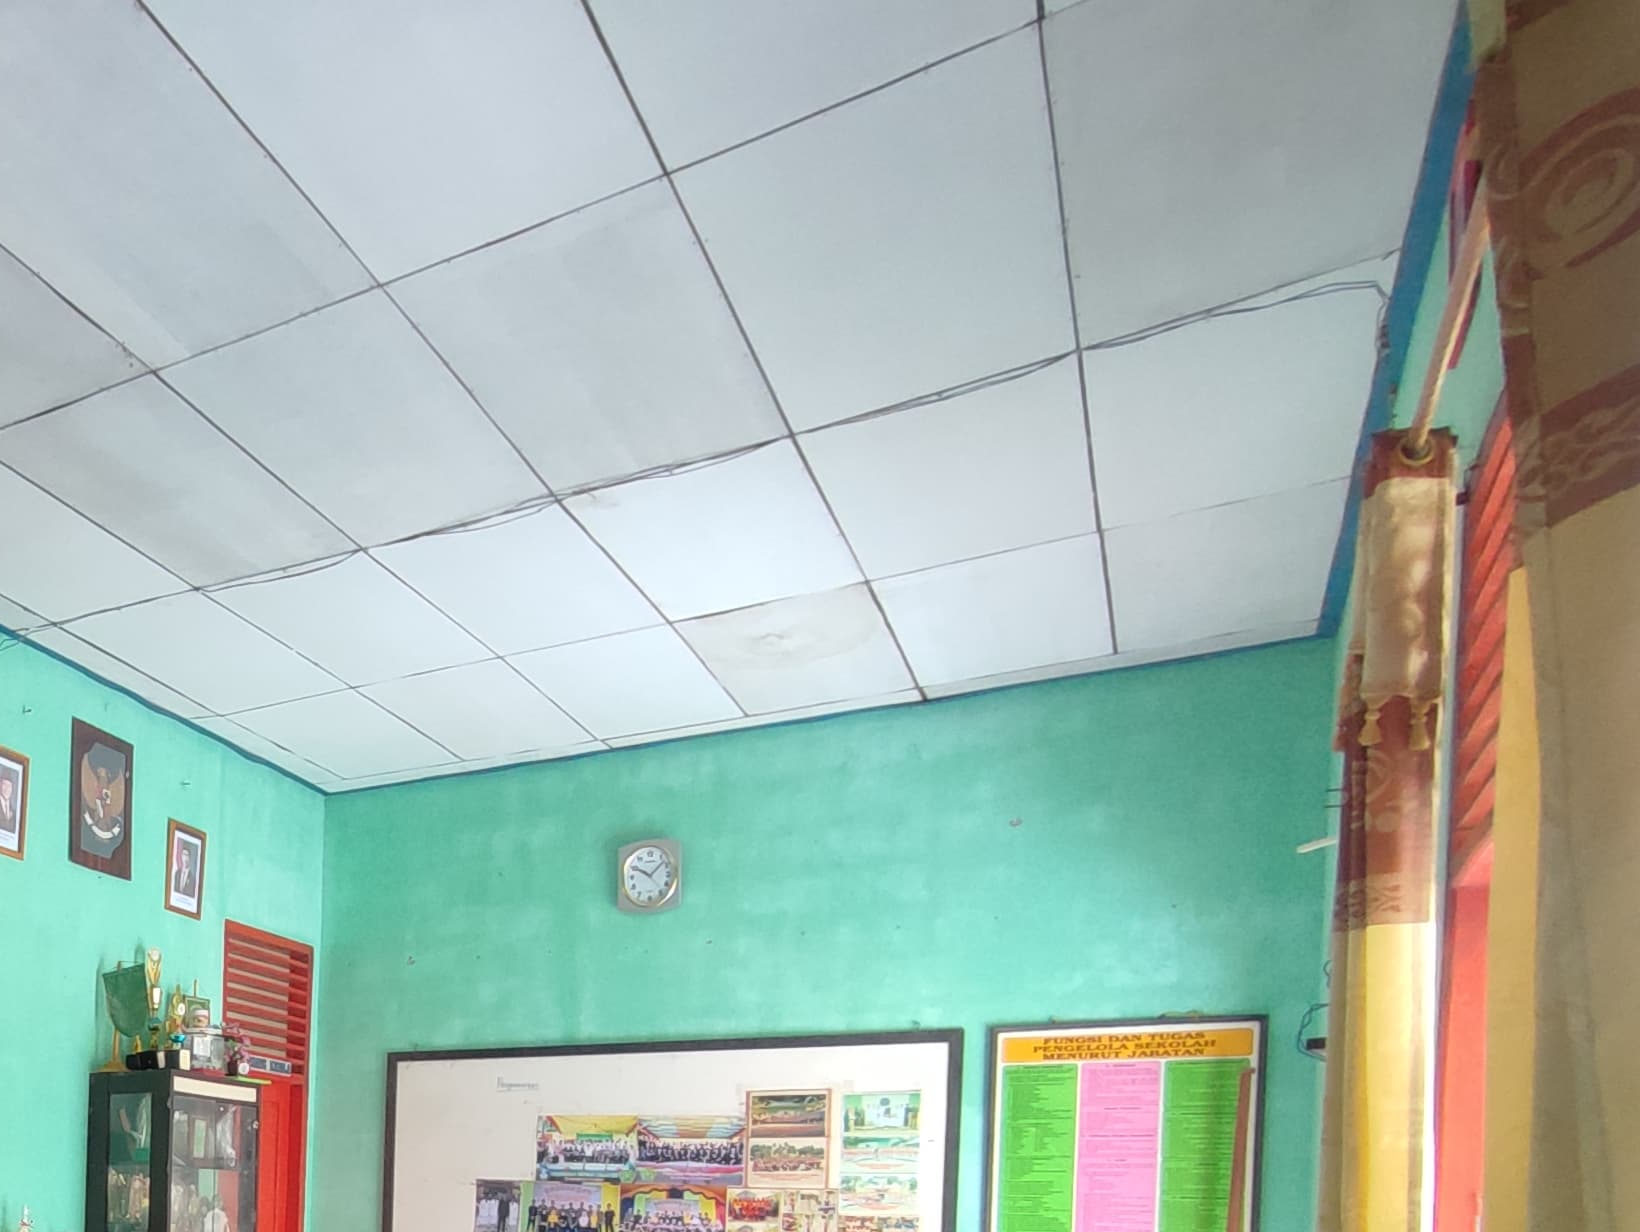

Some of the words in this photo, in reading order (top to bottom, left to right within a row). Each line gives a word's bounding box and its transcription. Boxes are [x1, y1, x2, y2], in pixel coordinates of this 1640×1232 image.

[1043, 1035, 1102, 1045] FUNGSI
[1108, 1033, 1142, 1043] DAN
[1148, 1031, 1206, 1041] TUGAS
[1033, 1043, 1129, 1053] PENGELOLA
[1134, 1039, 1217, 1050] SEKOLAH
[1042, 1050, 1122, 1060] MENURUT
[1127, 1048, 1205, 1058] JABATAN
